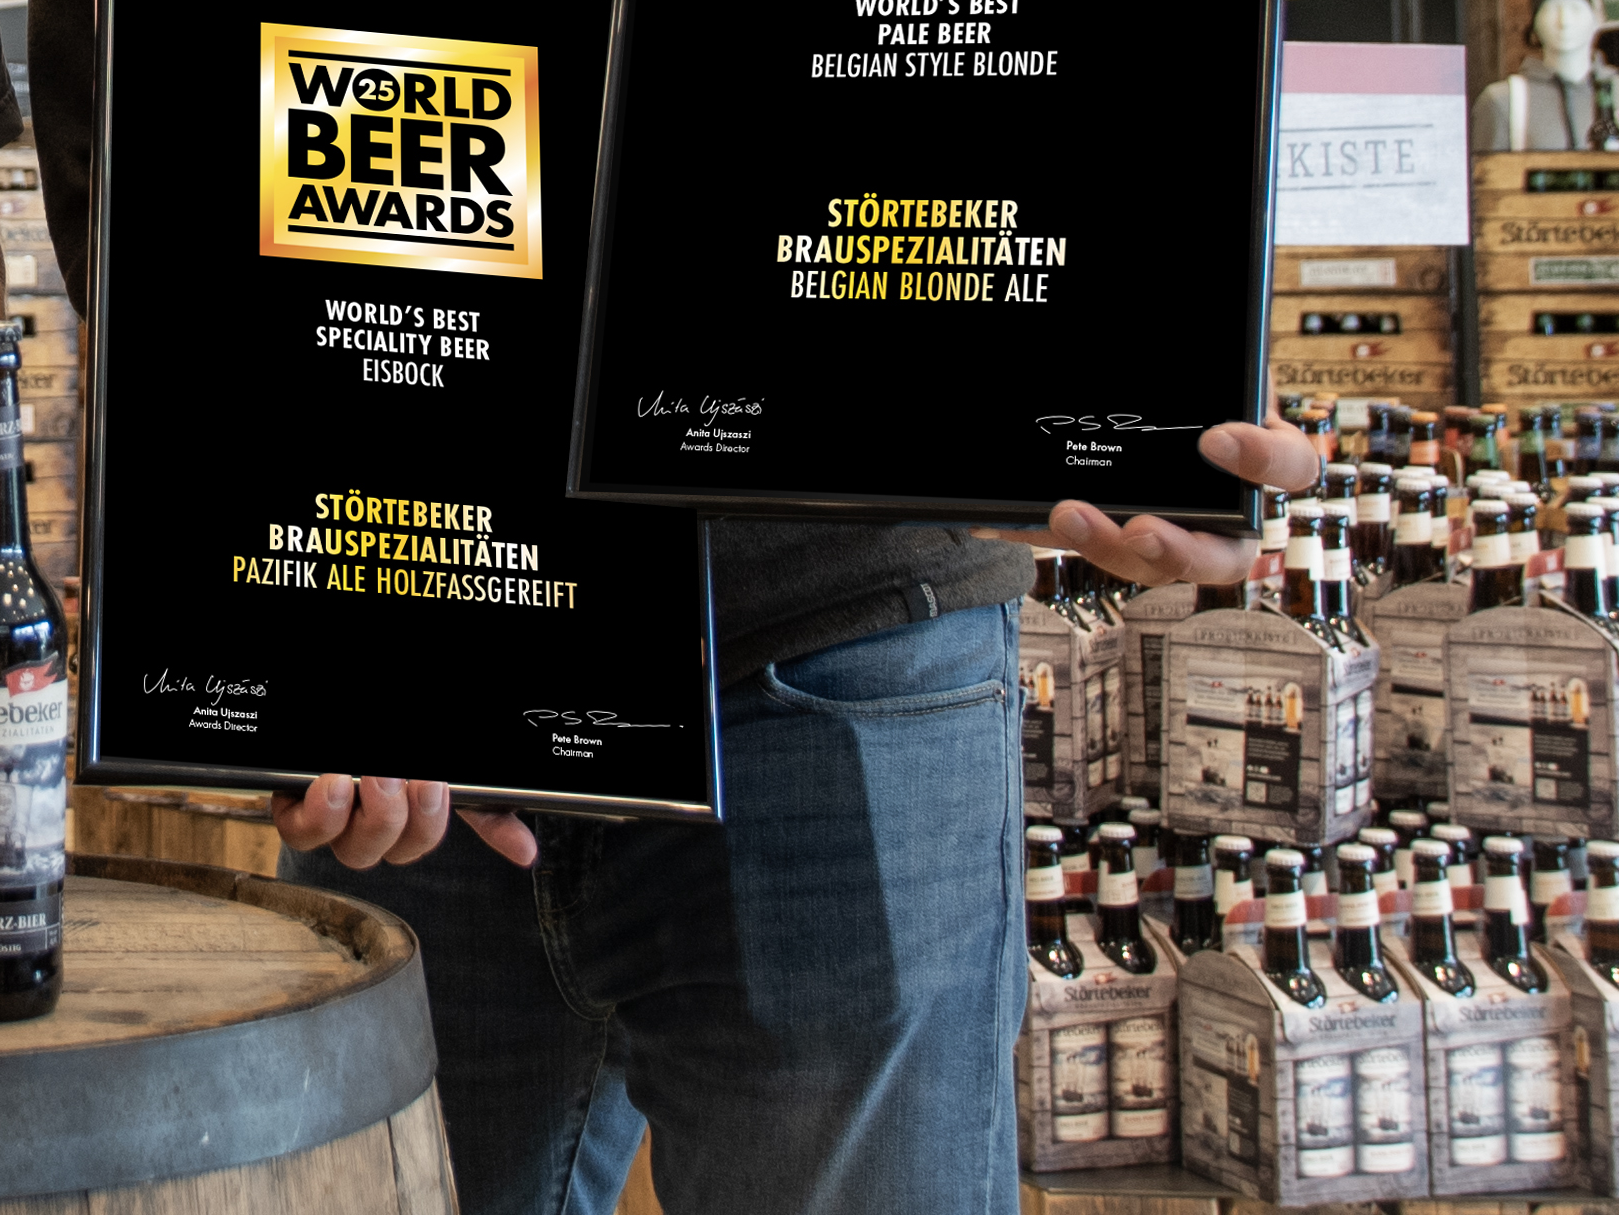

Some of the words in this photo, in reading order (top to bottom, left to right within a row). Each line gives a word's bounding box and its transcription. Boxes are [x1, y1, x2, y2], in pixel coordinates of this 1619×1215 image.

[877, 22, 930, 46] PALE
[937, 21, 992, 45] BEER
[811, 52, 898, 79] BELGIAN
[905, 51, 965, 78] STYLE
[973, 50, 1059, 77] BLONDE
[288, 108, 513, 196] BEER
[1277, 138, 1416, 178] KISTE
[288, 184, 514, 238] AWARDS
[827, 192, 1019, 229] STÖRTEBEKER
[776, 229, 1067, 267] BRAUSPEZIALITÄTEN
[790, 269, 888, 300] BELGIAN
[899, 271, 995, 302] BLONDE
[1004, 273, 1049, 303] ALE
[325, 299, 425, 328] WORLD'S
[433, 309, 480, 333] BEST
[316, 326, 432, 356] SPECIALITY
[440, 337, 490, 361] BEER
[363, 358, 444, 388] EISBOCK
[680, 441, 713, 452] Awards
[715, 442, 750, 454] Director
[685, 427, 711, 438] Anita
[713, 428, 752, 441] Ujszaszi
[1066, 440, 1088, 451] Pete
[1090, 441, 1123, 453] Brown
[1065, 454, 1113, 467] Chairman
[315, 488, 493, 533] STÖRTEBEKER
[268, 523, 539, 571] BRAUSPEZIALITÄTEN
[233, 555, 318, 589] PAZIFIK
[326, 562, 366, 593] ALE
[377, 567, 578, 609] HOLZFASSGEREIFT
[189, 718, 222, 730] Awards
[224, 720, 258, 732] Director
[193, 706, 218, 717] Anita
[220, 707, 258, 719] Ujszaszi
[552, 732, 571, 744] Pete
[573, 734, 603, 746] Brown
[552, 746, 594, 759] Chairman
